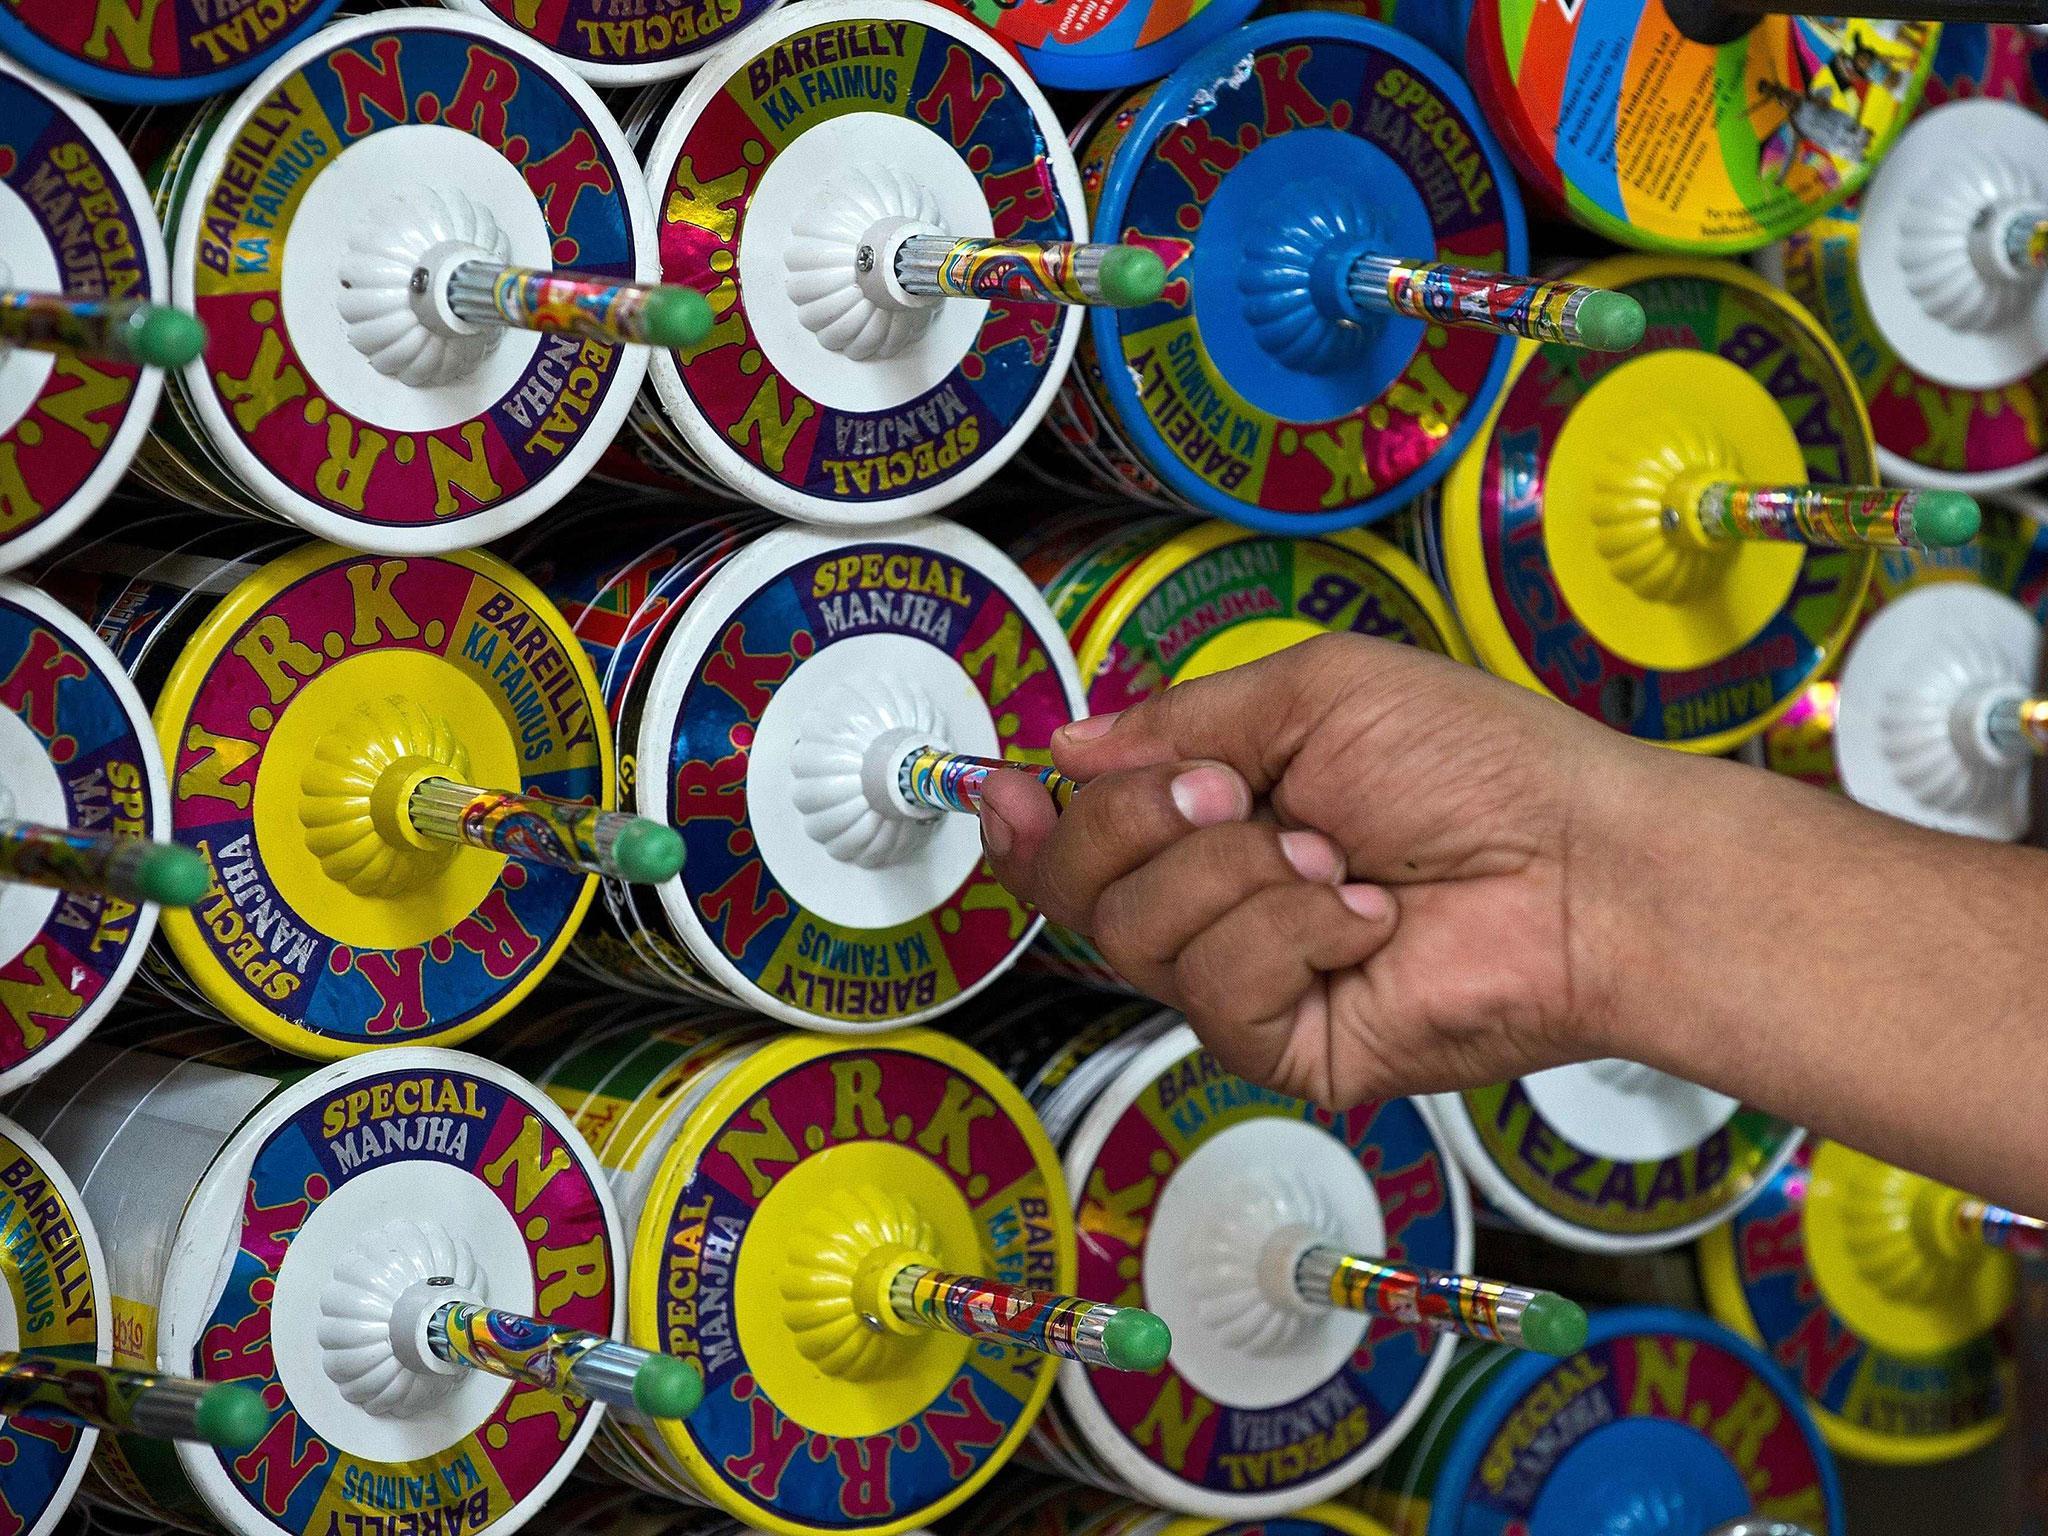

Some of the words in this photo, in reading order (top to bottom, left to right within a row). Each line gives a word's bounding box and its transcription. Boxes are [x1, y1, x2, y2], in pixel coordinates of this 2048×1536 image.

[190, 0, 312, 64] CIAL
[749, 24, 908, 101] BAREILLY
[327, 36, 613, 265] N.R.K.
[761, 95, 806, 132] KA
[801, 64, 899, 107] FAIMUS
[1374, 69, 1493, 216] SPECIAL
[22, 161, 101, 297] MANJH
[51, 143, 143, 299] SPECIA
[200, 87, 303, 278] BAREILLY
[246, 128, 329, 230] FAIMUS
[234, 237, 272, 274] KA
[501, 334, 581, 429] NJHA
[524, 337, 613, 457] ECIAL
[834, 382, 970, 455] MANJHA
[1129, 346, 1252, 491] BAREILLY
[822, 415, 981, 495] SPECIAL
[812, 553, 973, 609] SPECIAL
[817, 588, 954, 645] MANJHA
[178, 559, 446, 810] N.R.K.
[460, 622, 494, 669] KA
[492, 651, 553, 763] FAIMUS
[476, 591, 594, 752] BAREILLY
[675, 621, 816, 960] N.R.K.
[196, 839, 301, 1000] SPECI
[217, 833, 319, 974] MANJHA
[796, 921, 890, 982] FAIMUS
[897, 929, 930, 970] KA
[775, 963, 938, 1016] BAREILLY
[323, 1078, 488, 1138] SPECIAL
[331, 1116, 471, 1176] MANJHA
[717, 1057, 998, 1201] N.R.K.
[0, 1156, 94, 1327] BAREILLY
[5, 1216, 56, 1333] FAIMUS
[700, 1215, 746, 1374] MANJHA
[341, 1463, 441, 1511] FAIMUS
[440, 1451, 482, 1498] KA
[725, 1373, 1003, 1519] N.R.K.
[1217, 1404, 1370, 1489] SPECIAL
